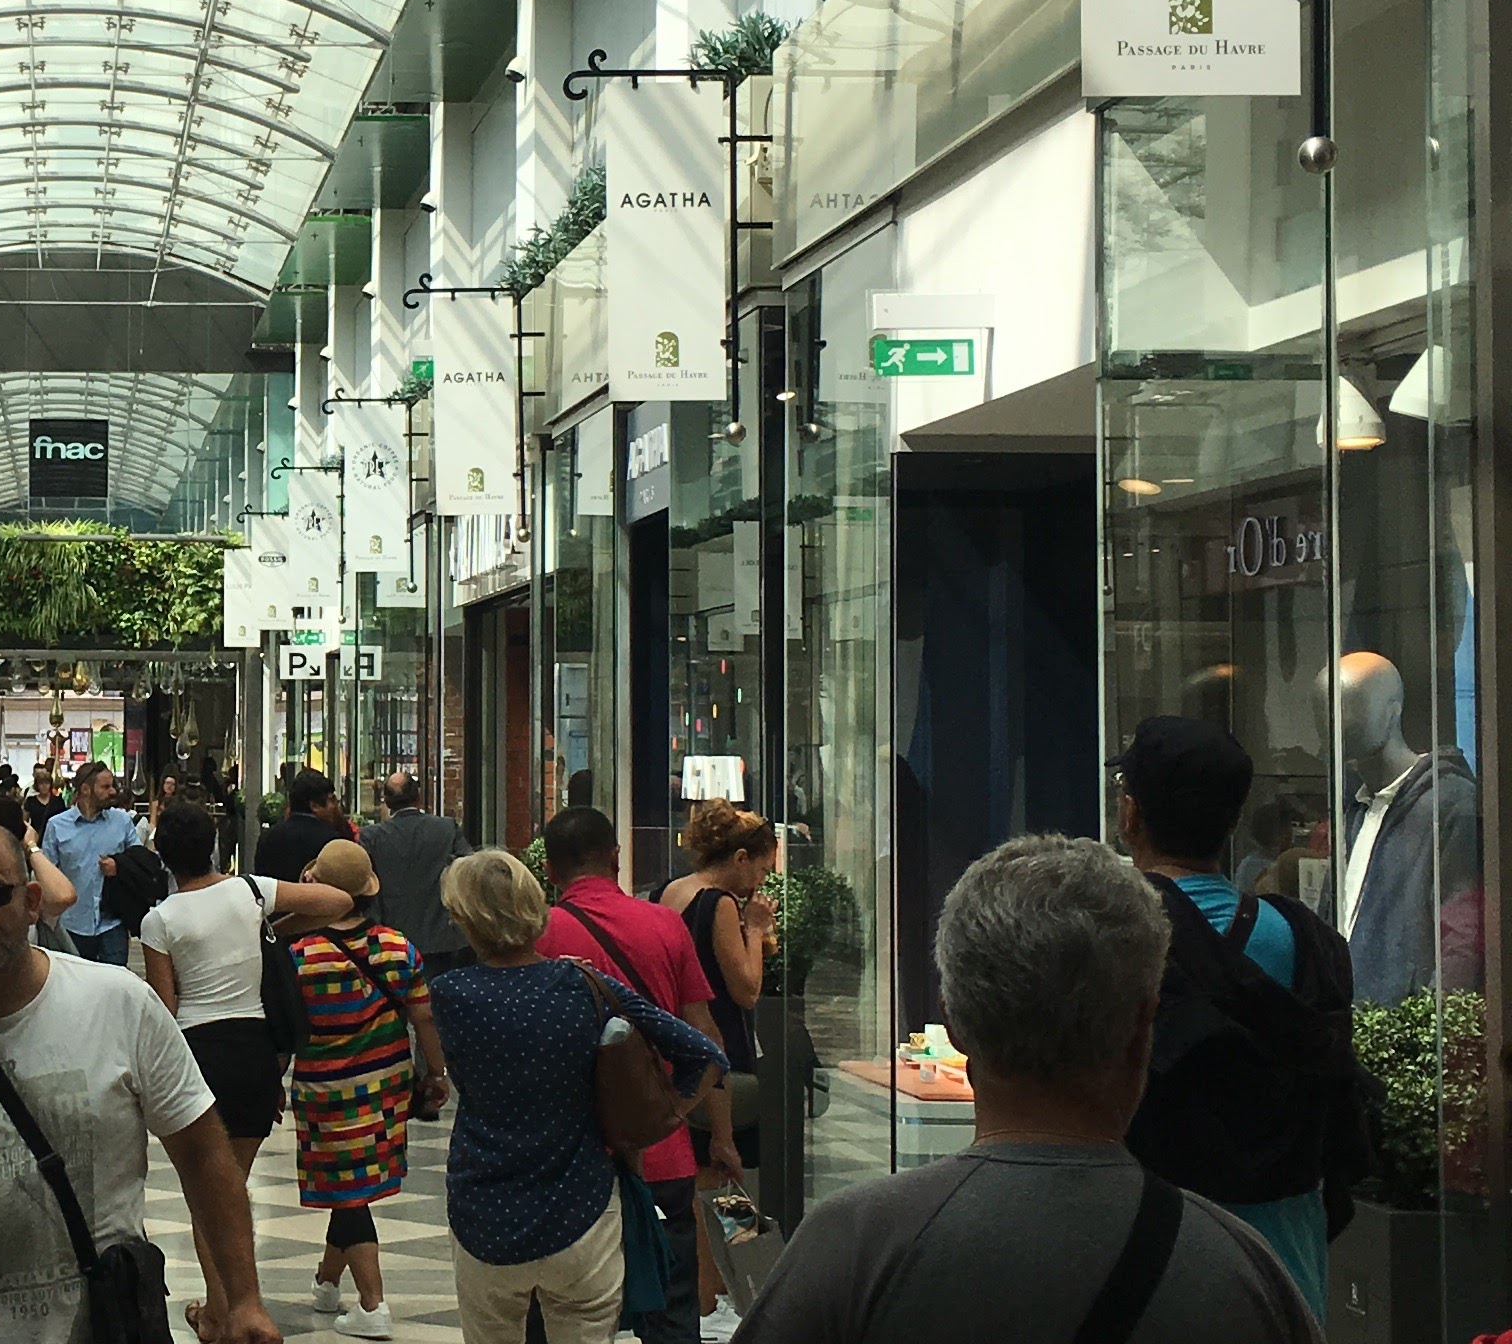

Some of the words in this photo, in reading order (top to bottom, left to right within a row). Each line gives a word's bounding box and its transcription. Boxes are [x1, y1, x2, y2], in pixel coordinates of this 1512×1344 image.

[1117, 40, 1182, 56] PASSAGE
[1188, 45, 1208, 55] DU
[1215, 39, 1266, 55] HAVRE
[620, 192, 711, 208] AGATHA
[443, 371, 506, 383] AGATHA
[33, 436, 104, 459] fnac
[289, 653, 307, 676] P
[11, 1302, 50, 1320] 1950
